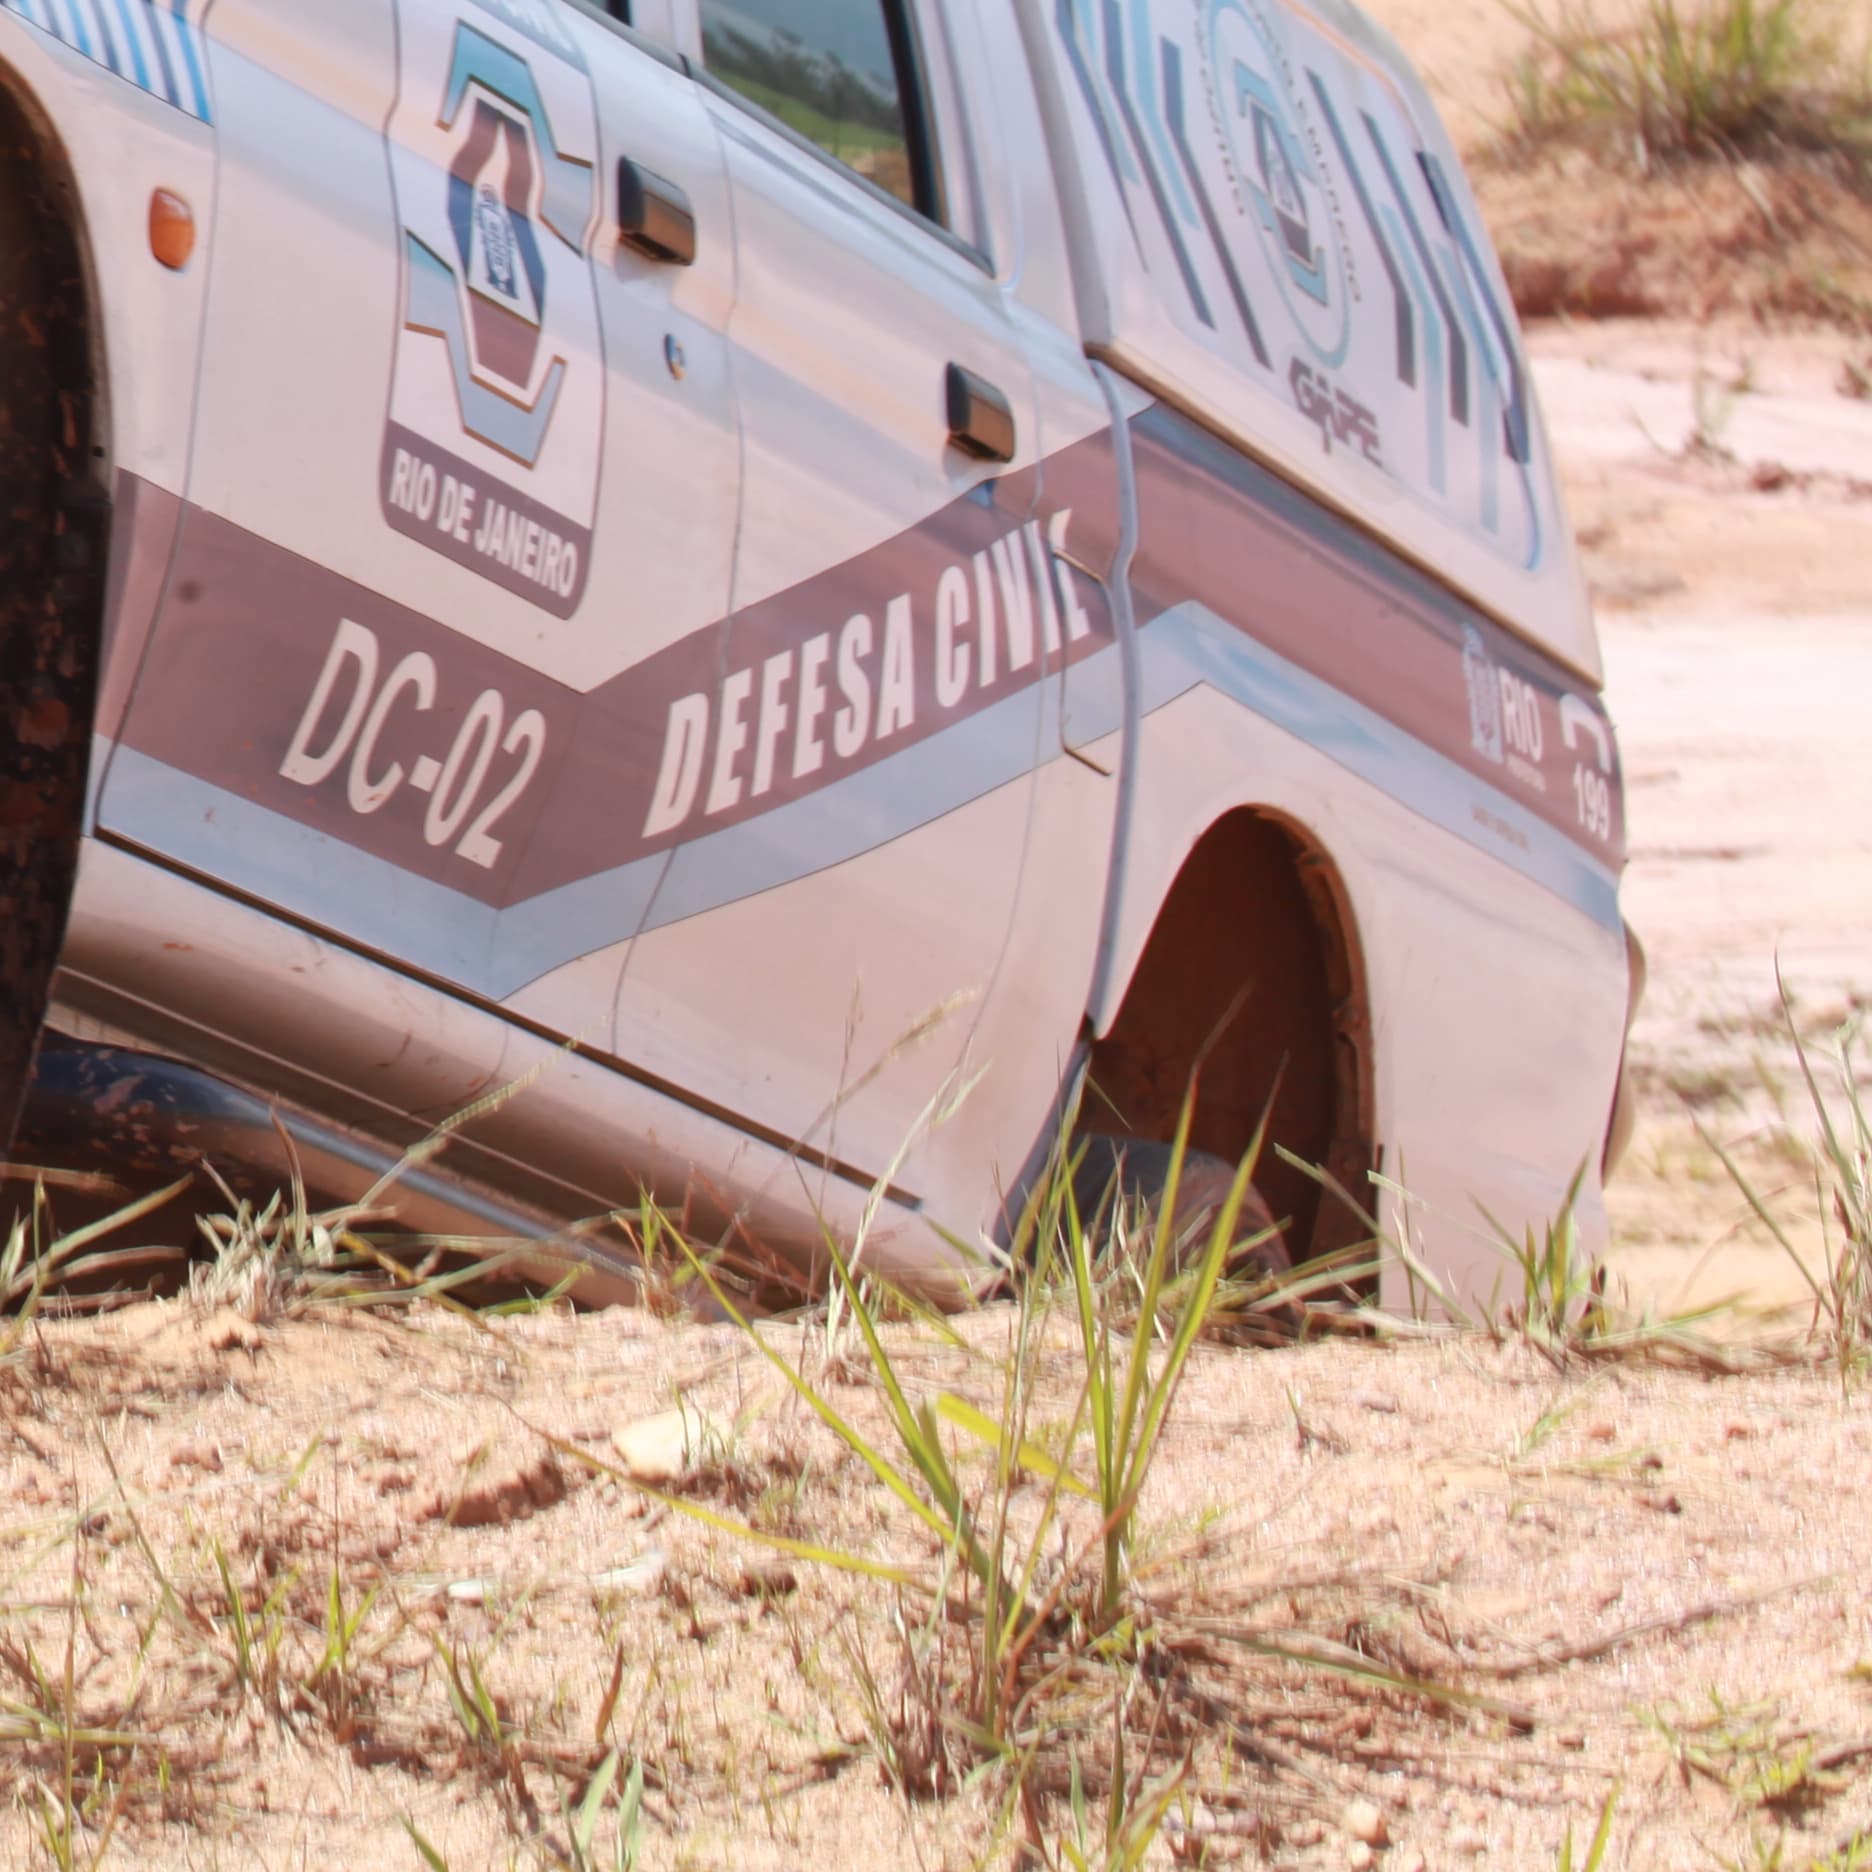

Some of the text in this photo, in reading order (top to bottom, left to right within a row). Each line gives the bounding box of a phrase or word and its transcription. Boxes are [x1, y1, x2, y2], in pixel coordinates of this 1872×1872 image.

[389, 447, 578, 599] RIO DE JANEIRO
[278, 617, 547, 869] DC-02
[641, 508, 1091, 839] DEFESA CIVIL
[1499, 666, 1542, 763] RIO
[1573, 760, 1610, 841] 199
